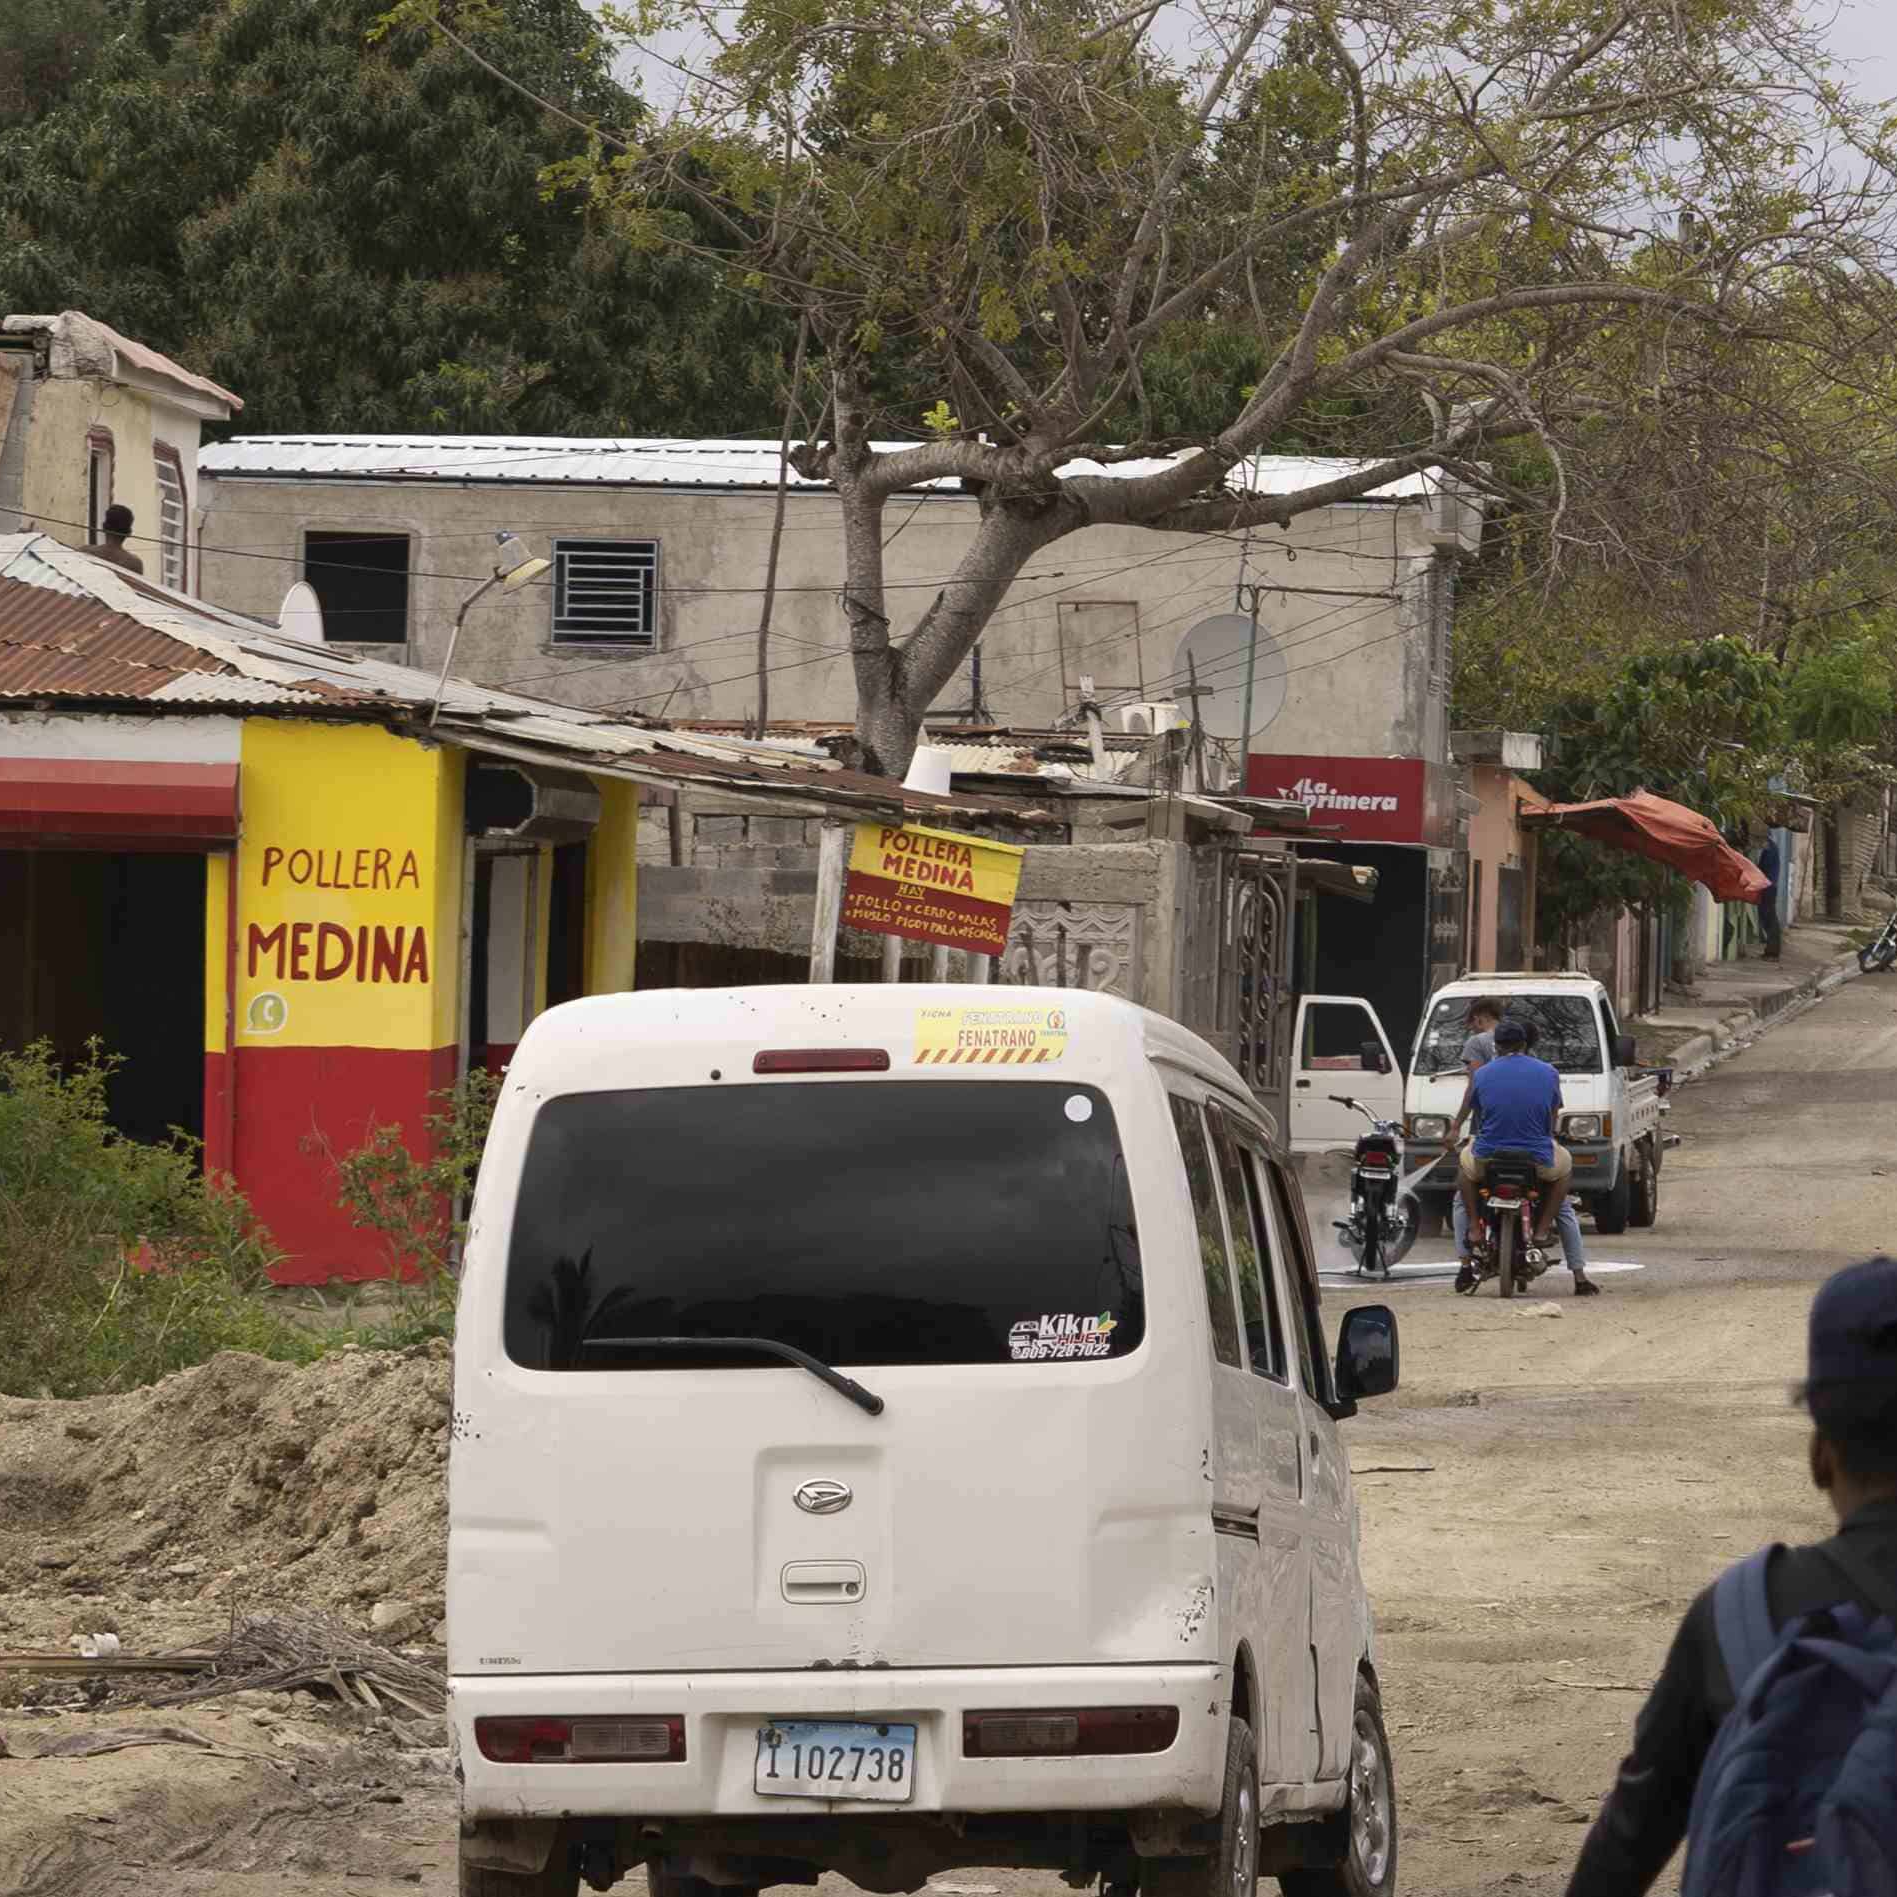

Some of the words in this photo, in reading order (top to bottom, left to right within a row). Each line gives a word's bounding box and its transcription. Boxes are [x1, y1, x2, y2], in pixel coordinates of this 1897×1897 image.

[1303, 788, 1399, 811] primera
[1304, 778, 1328, 794] La
[879, 828, 972, 868] POLLERA
[262, 847, 420, 890] POLLERA
[883, 852, 974, 892] MEDINA
[897, 883, 926, 898] HAY
[855, 893, 902, 912] POLLO
[913, 903, 956, 921] CERDO
[853, 909, 892, 924] MUSLO
[930, 921, 959, 936] PALA
[248, 922, 429, 984] MEDINA
[958, 1029, 1036, 1047] FENATRANO
[1056, 1331, 1111, 1345] HIJET
